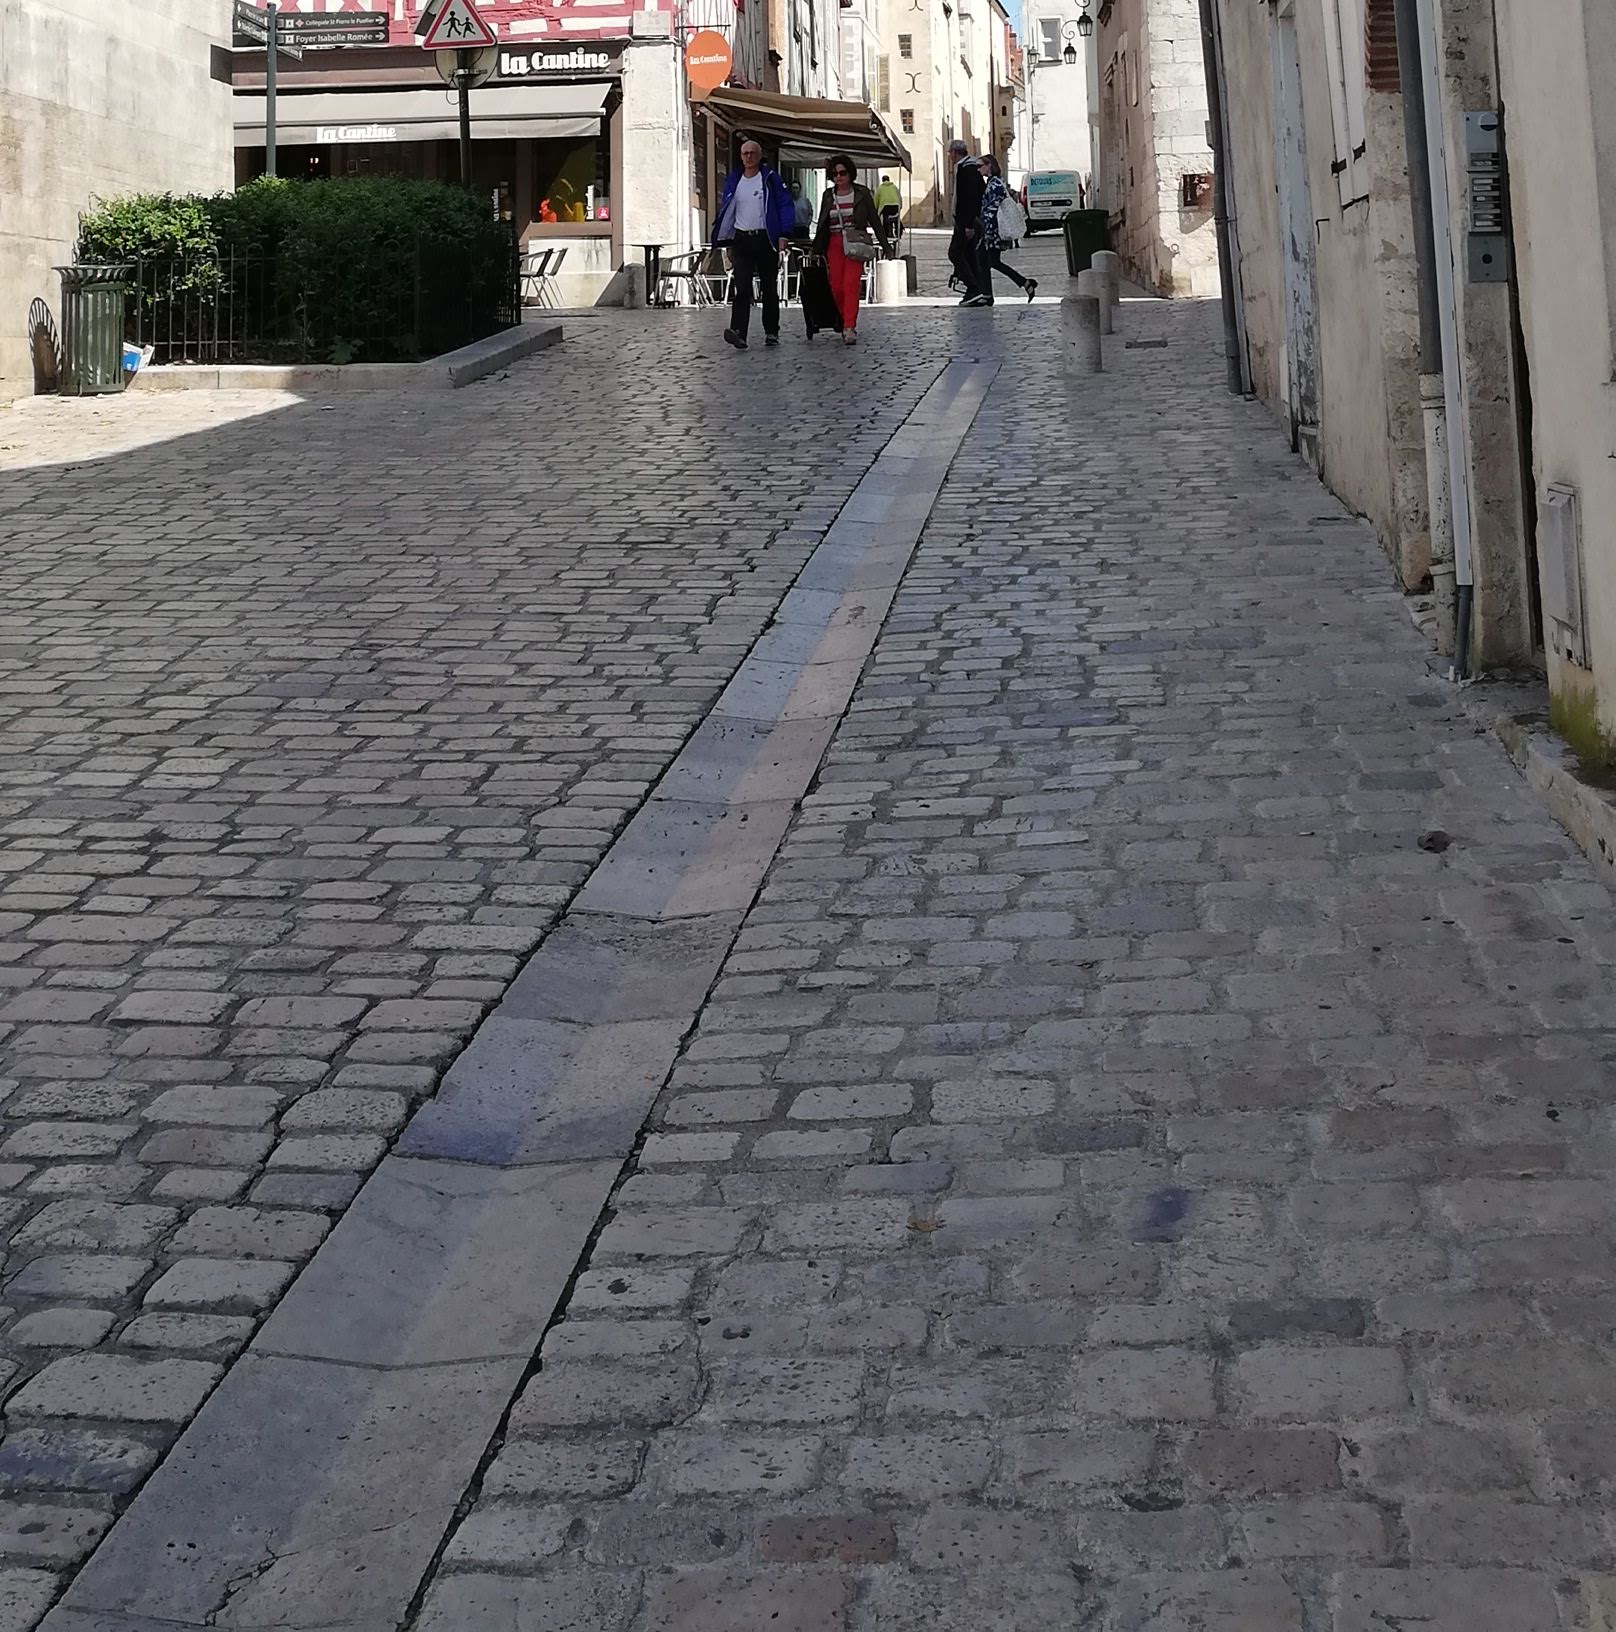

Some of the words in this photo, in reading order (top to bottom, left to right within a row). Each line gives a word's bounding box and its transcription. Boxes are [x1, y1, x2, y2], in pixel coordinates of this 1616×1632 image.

[296, 35, 316, 44] Foyer
[318, 34, 345, 42] Isabelle
[347, 32, 373, 41] Romée
[531, 47, 611, 70] Cantine
[700, 53, 727, 63] Cantine
[338, 124, 397, 140] Cantine
